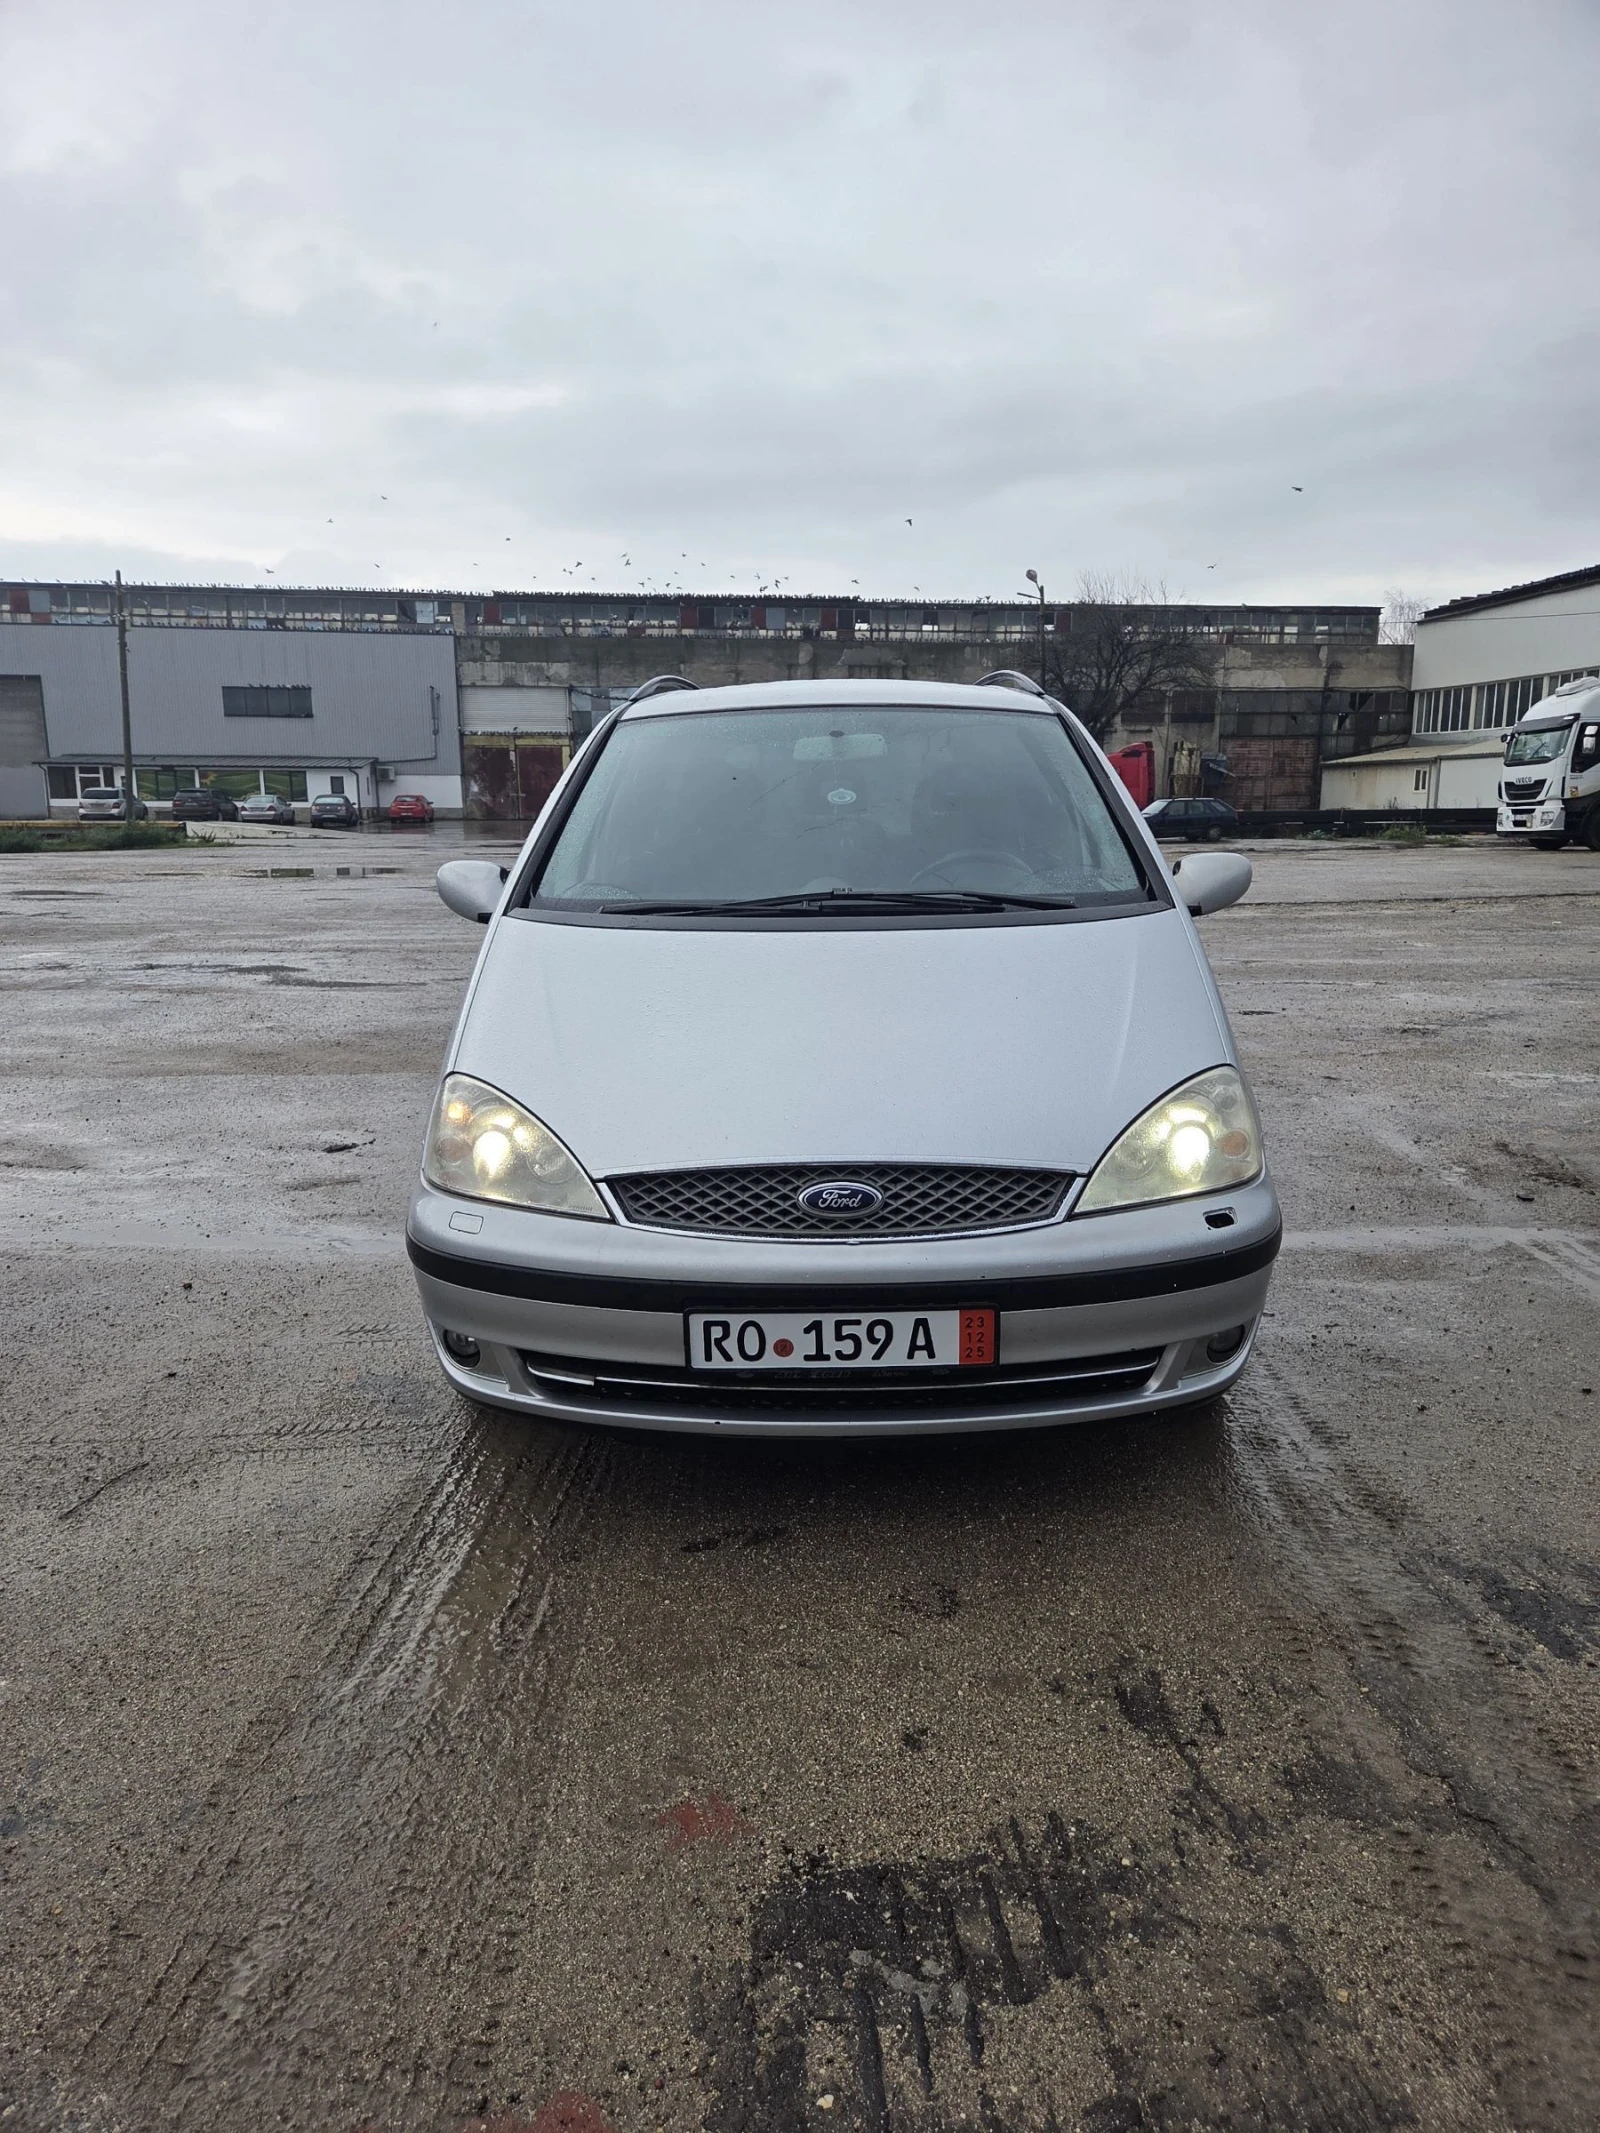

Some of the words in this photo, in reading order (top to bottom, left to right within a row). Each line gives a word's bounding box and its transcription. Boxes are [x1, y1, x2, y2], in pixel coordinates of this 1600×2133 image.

[1515, 776, 1532, 784] IVECO
[818, 1190, 862, 1207] Ford
[965, 1316, 984, 1328] 23
[702, 1320, 766, 1362] RO
[802, 1318, 894, 1362] 159
[906, 1317, 936, 1360] A
[966, 1331, 984, 1343] 12
[965, 1346, 984, 1358] 25
